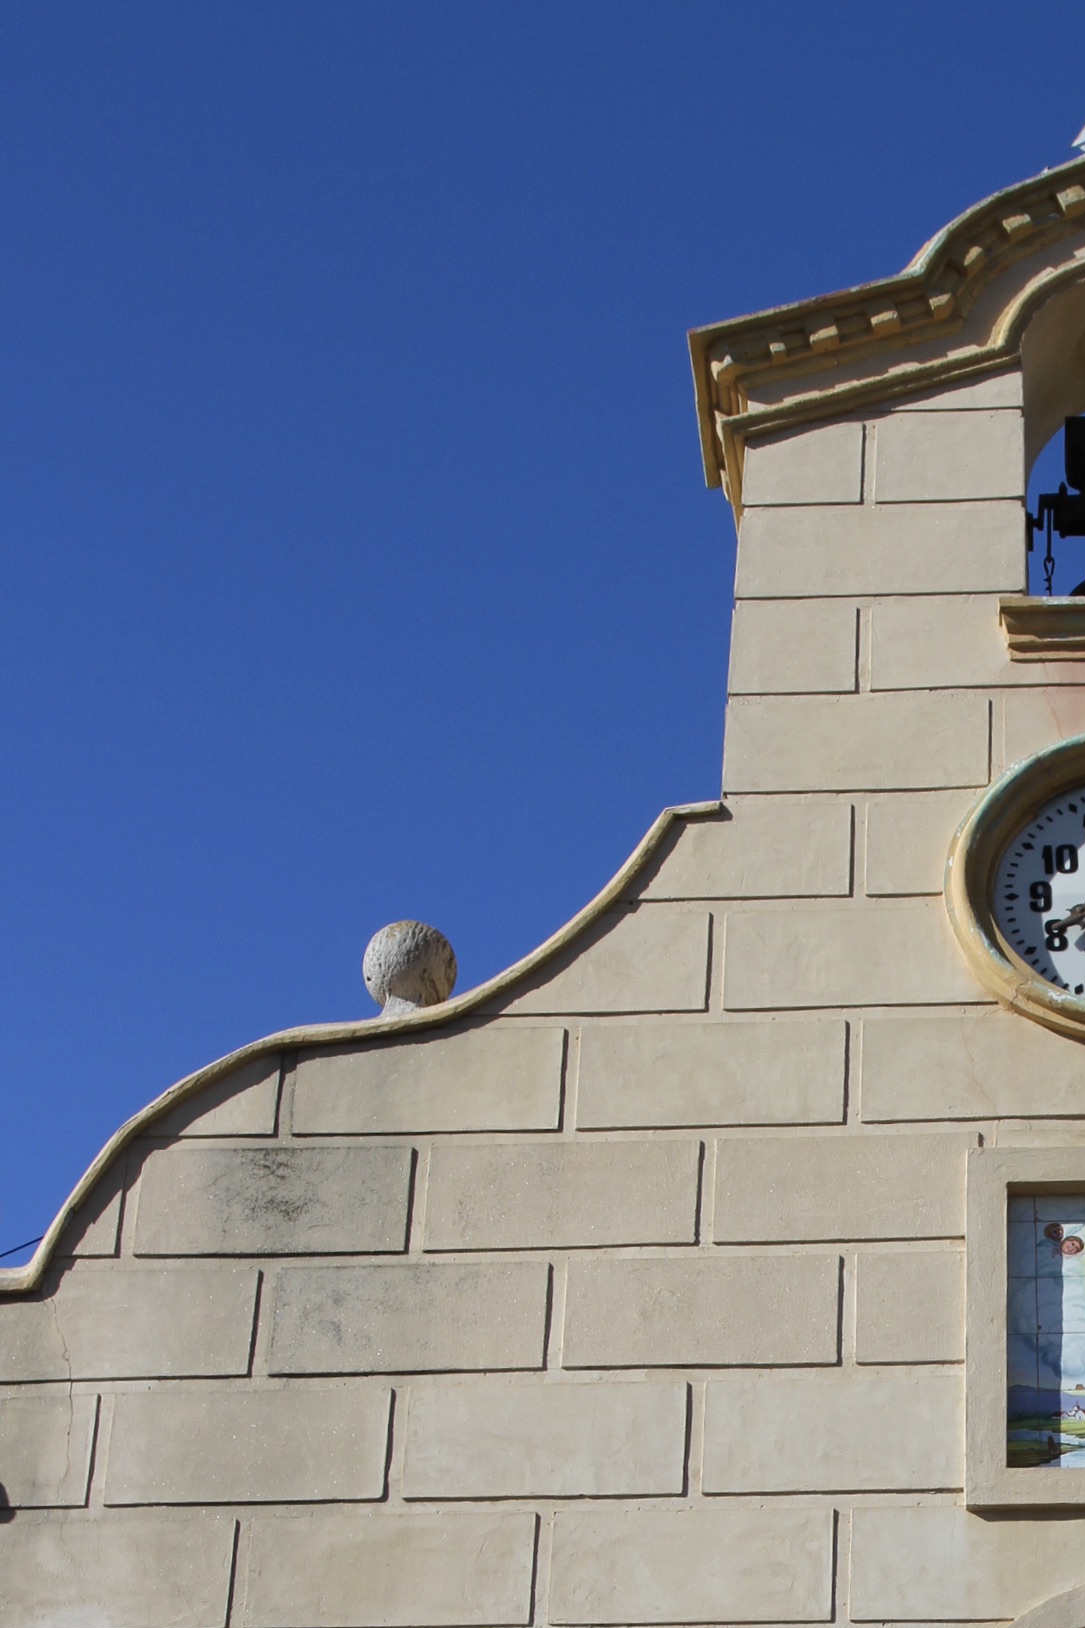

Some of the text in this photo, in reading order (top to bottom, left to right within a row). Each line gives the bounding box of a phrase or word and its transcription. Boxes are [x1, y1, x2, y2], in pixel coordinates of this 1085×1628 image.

[1042, 844, 1079, 874] 10
[1029, 881, 1052, 913] 9
[1044, 919, 1069, 952] 8
